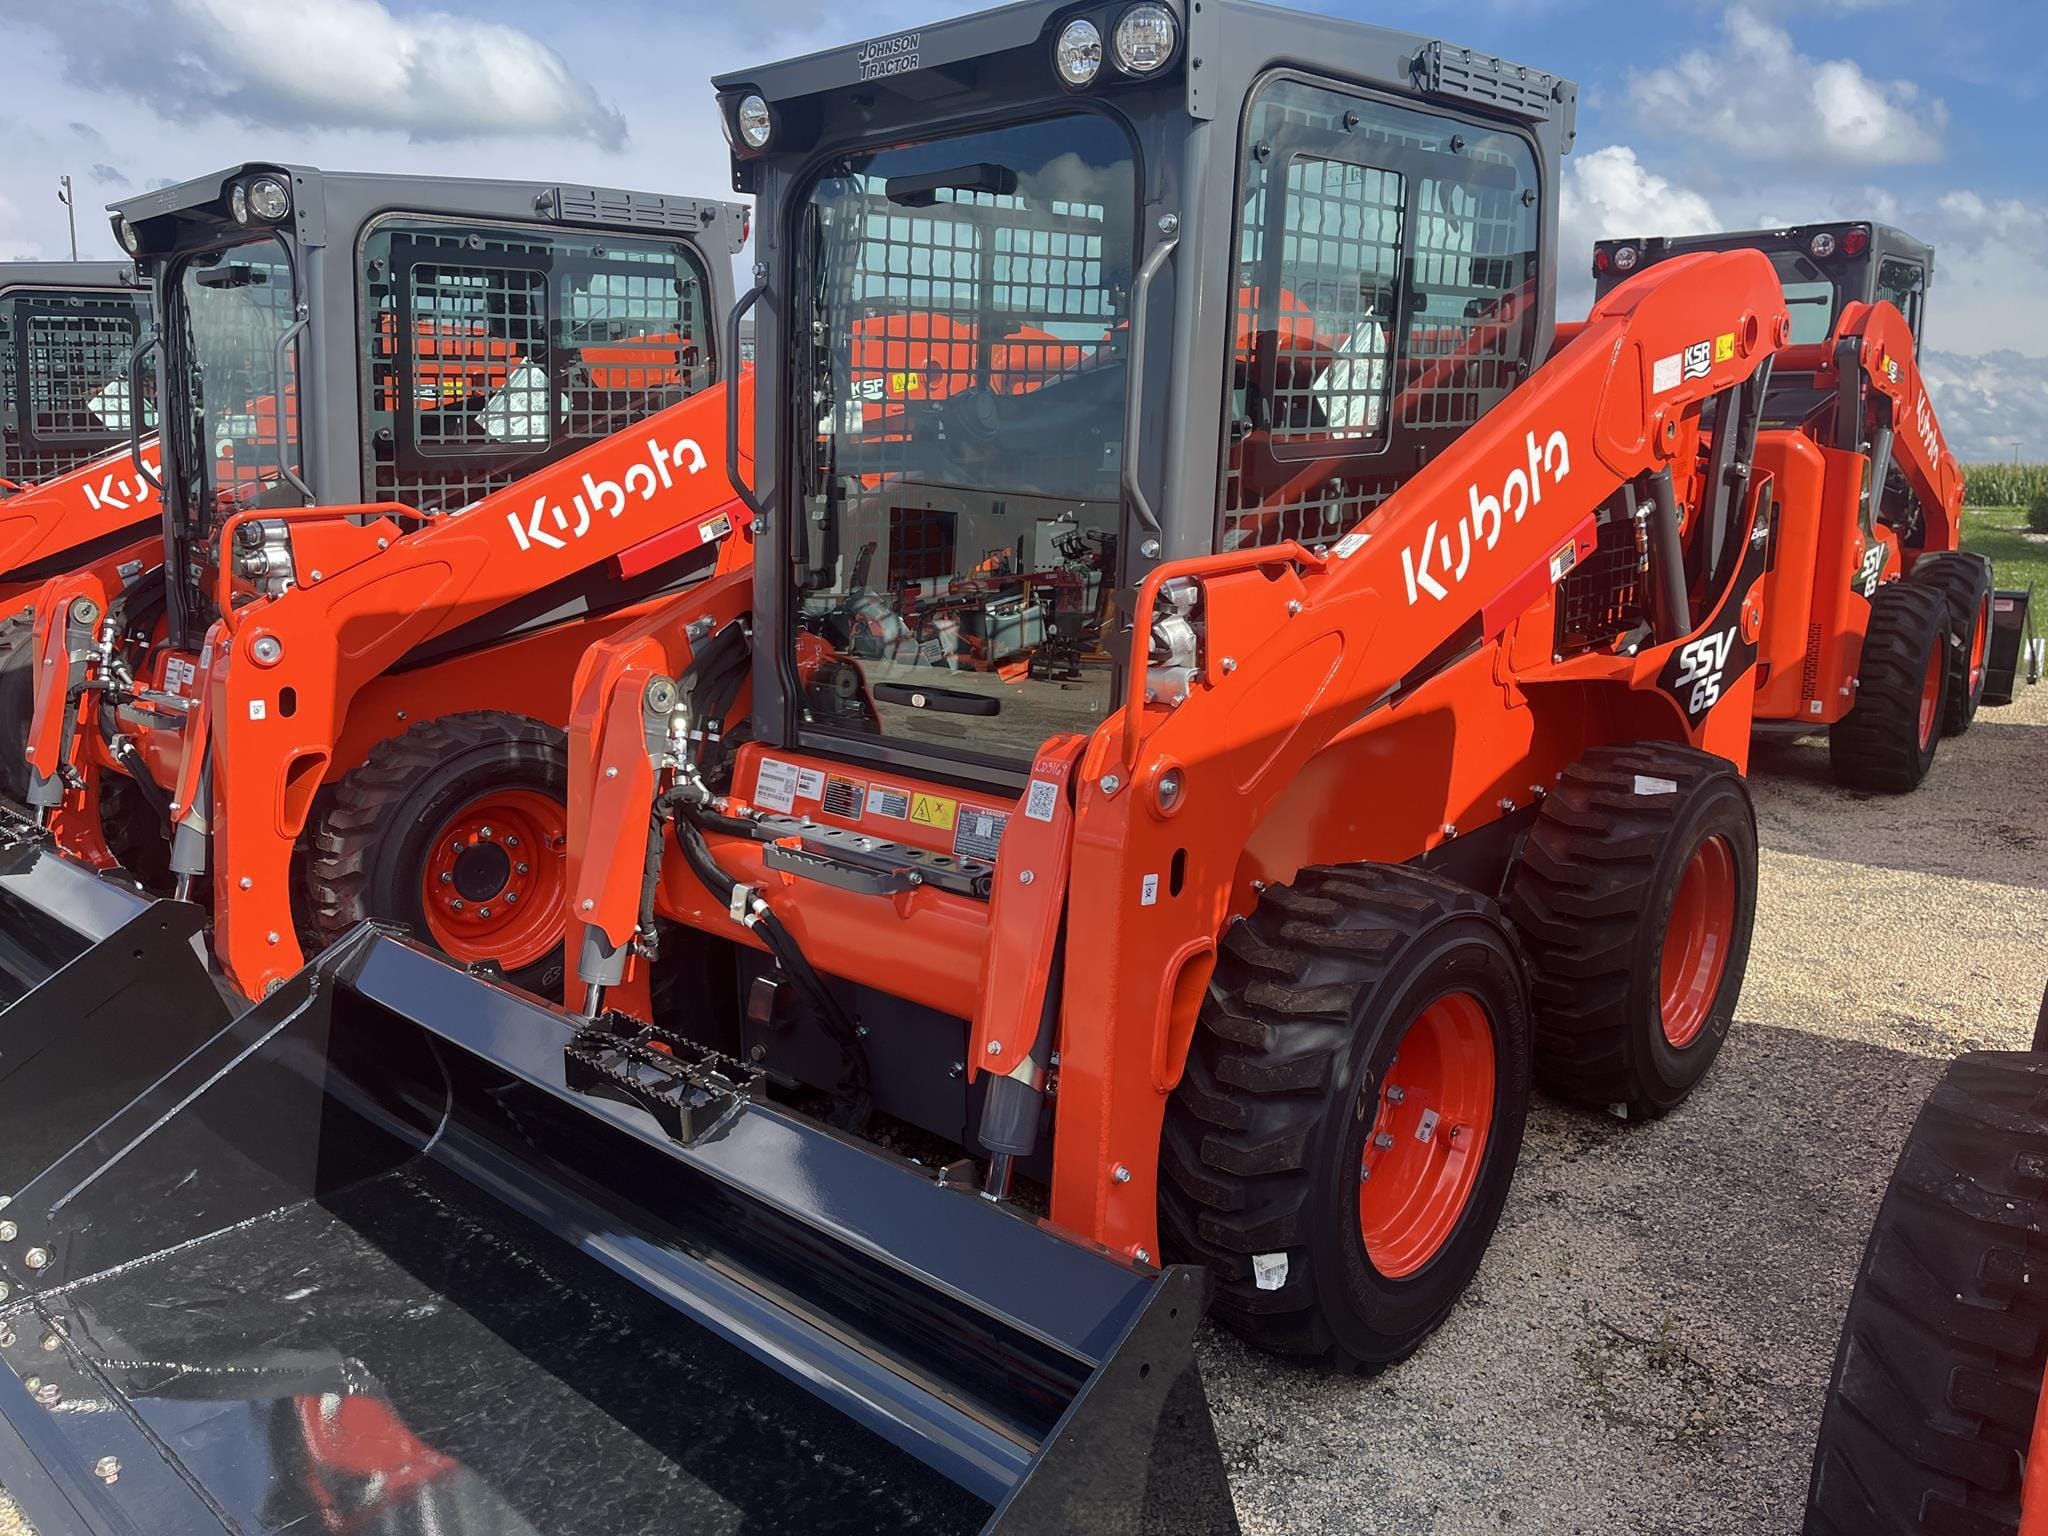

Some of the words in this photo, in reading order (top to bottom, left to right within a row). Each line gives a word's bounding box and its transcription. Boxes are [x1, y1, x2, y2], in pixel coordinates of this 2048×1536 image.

[858, 33, 920, 61] JOHNSON
[859, 54, 919, 80] TRACTOR
[1684, 341, 1710, 367] KSR
[506, 438, 708, 551] Kubota
[1401, 430, 1570, 606] Kubota
[1675, 626, 1737, 688] SSV
[1689, 671, 1723, 714] 65
